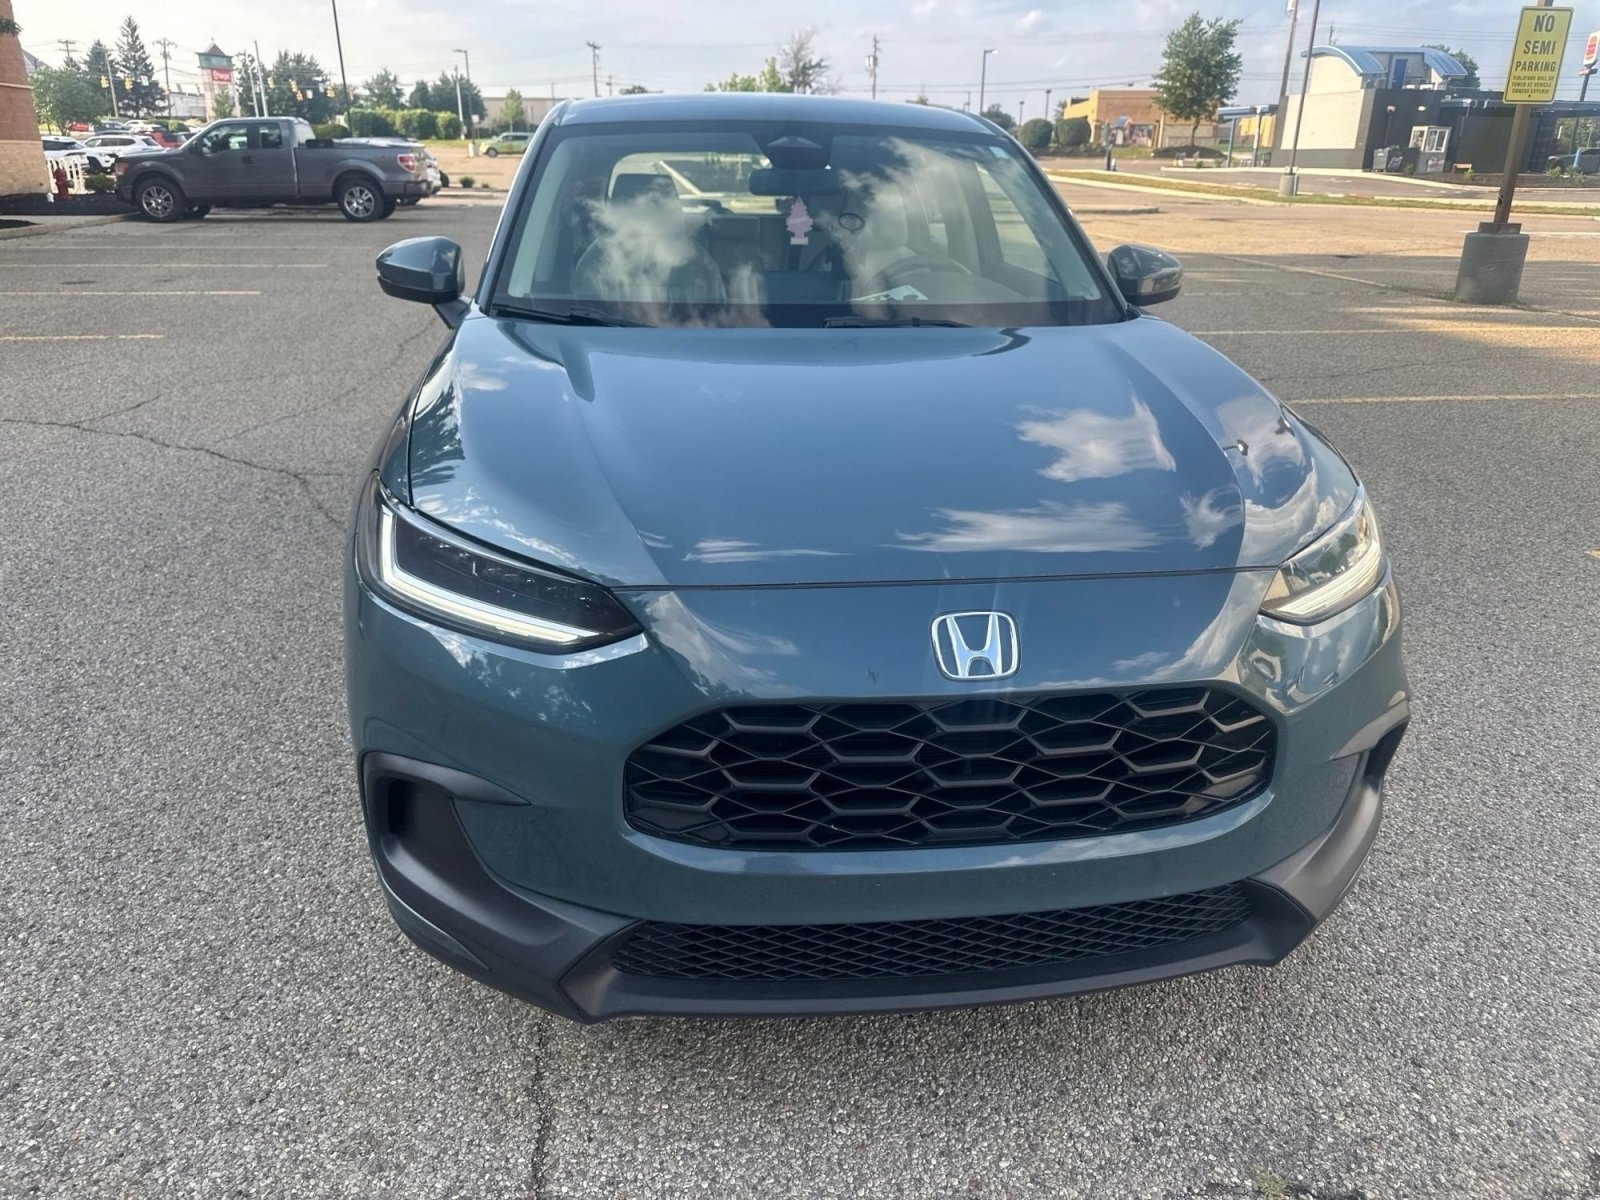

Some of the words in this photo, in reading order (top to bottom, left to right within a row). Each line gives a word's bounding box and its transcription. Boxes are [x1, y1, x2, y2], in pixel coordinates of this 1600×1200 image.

[1534, 15, 1555, 32] NO
[1523, 40, 1556, 55] SEMI
[1515, 61, 1557, 72] PARKING
